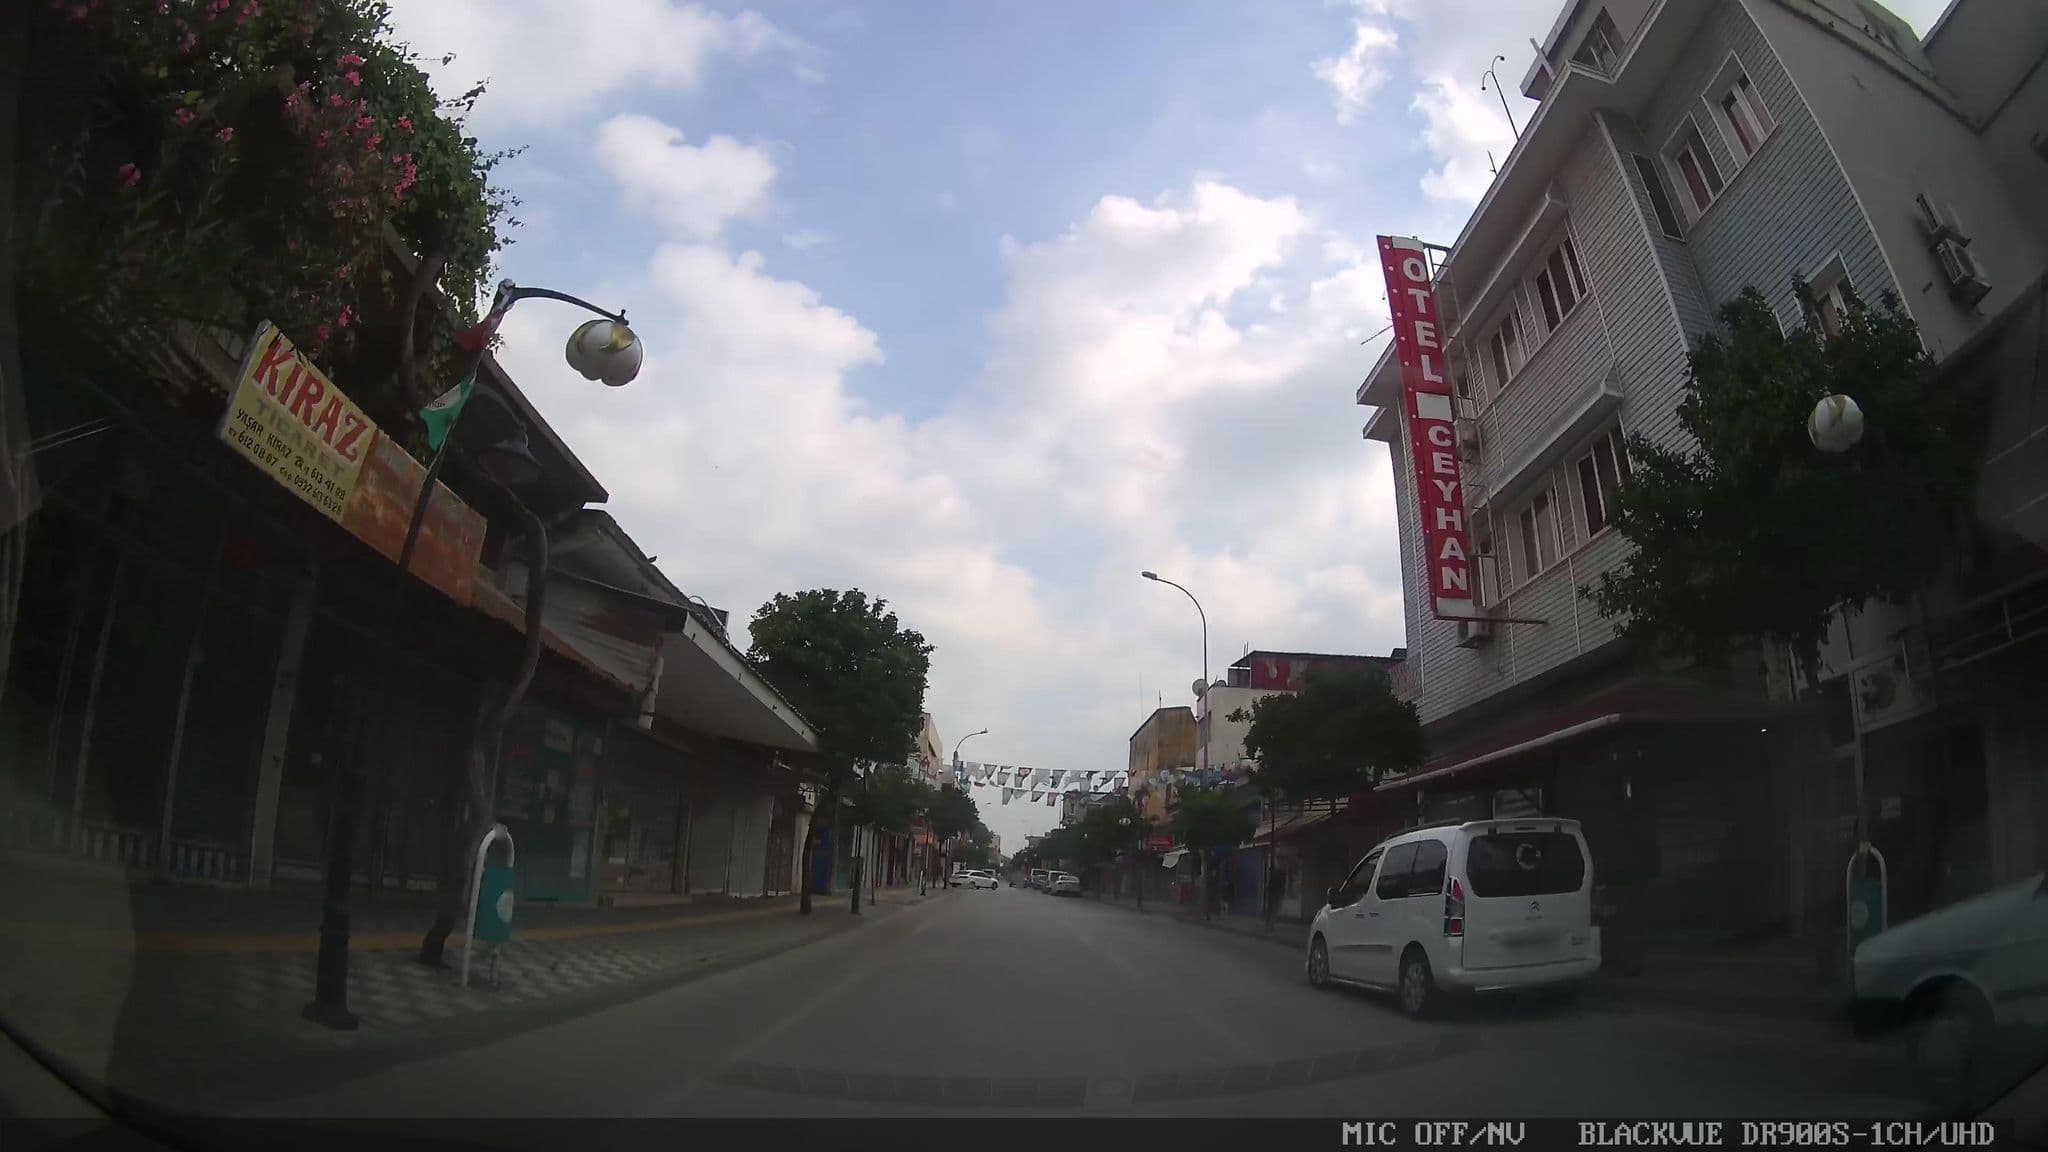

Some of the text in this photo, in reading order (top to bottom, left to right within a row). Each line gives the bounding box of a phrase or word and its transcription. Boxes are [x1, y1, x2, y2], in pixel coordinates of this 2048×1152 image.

[1401, 257, 1444, 384] OTEL
[238, 431, 253, 450] 612
[266, 454, 278, 468] 07
[252, 339, 369, 463] KIRAZ
[266, 433, 292, 459] KIRAZ
[1428, 426, 1466, 591] CEYHAN
